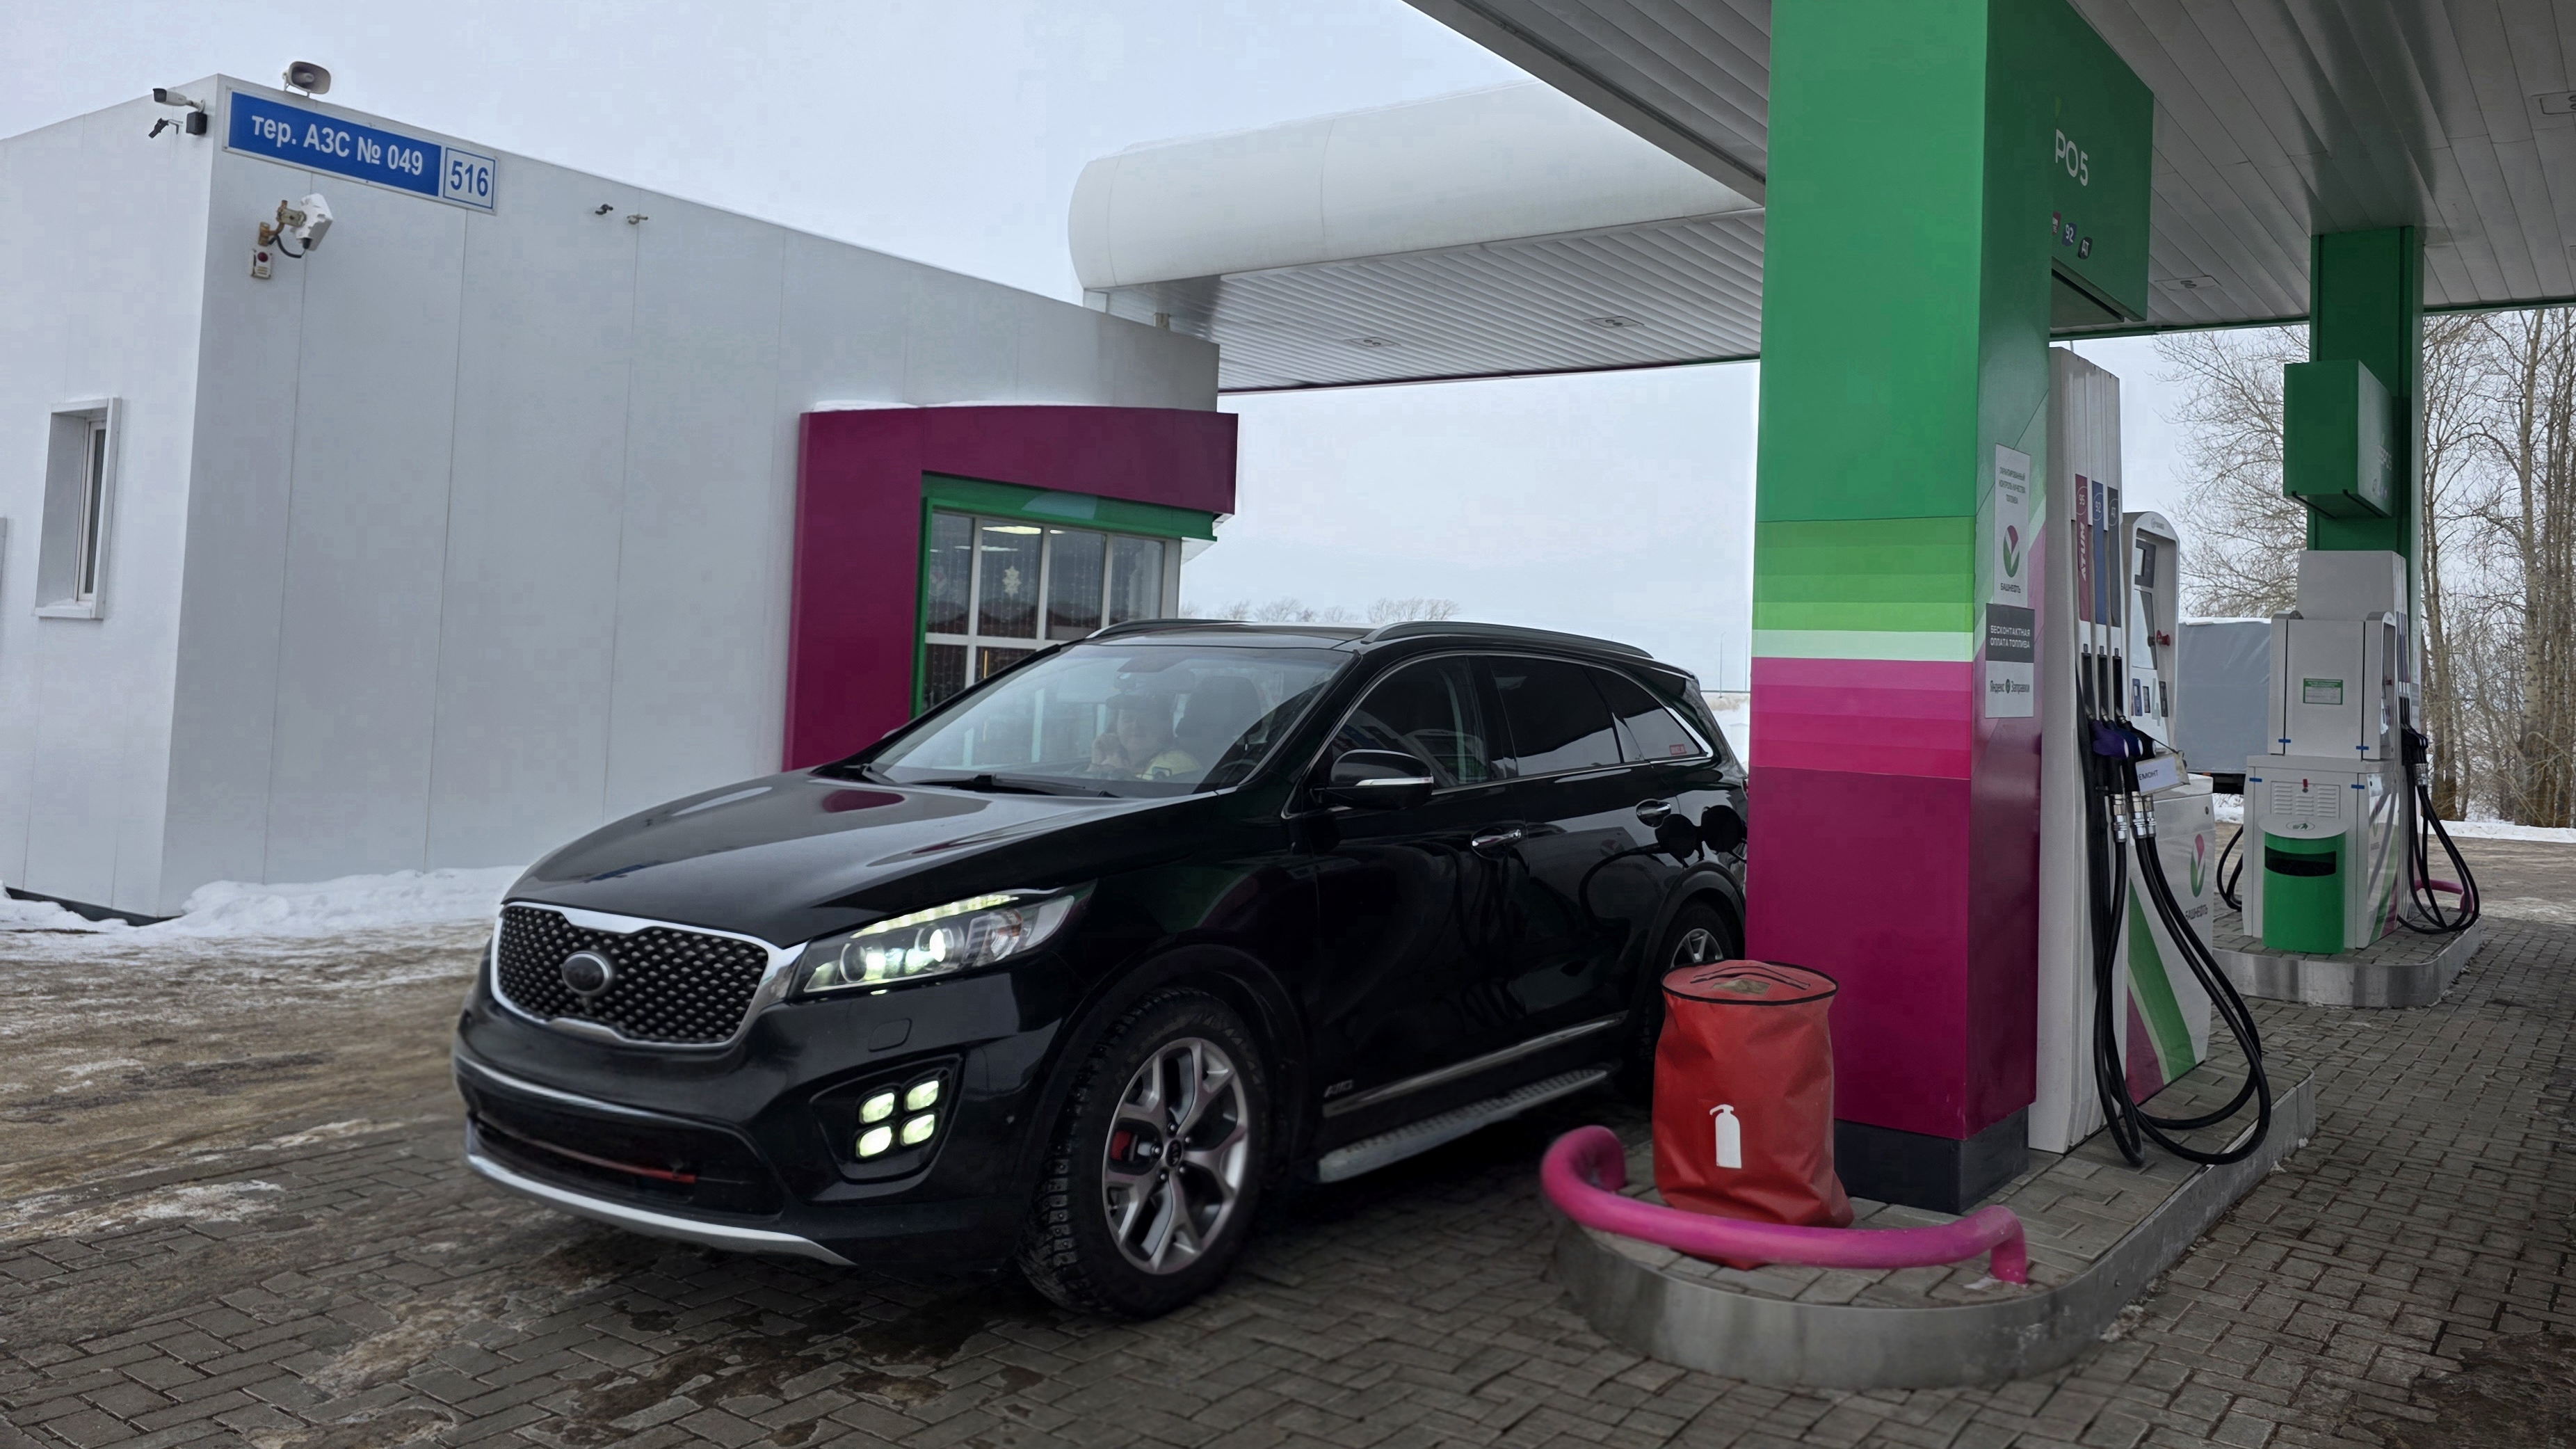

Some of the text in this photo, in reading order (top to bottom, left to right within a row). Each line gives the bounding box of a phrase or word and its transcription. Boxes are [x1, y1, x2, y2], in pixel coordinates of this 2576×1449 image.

[252, 115, 424, 176] тер. АЗС № 049
[2055, 129, 2088, 187] РО5
[450, 159, 489, 198] 516
[2066, 223, 2074, 243] 92
[2079, 493, 2086, 506] 95
[2095, 500, 2102, 513] 92
[1990, 625, 2031, 637] БЕСКОНТАКТНАЯ
[1990, 637, 2031, 649] ОПЛАТА ТОПЛИВА
[1990, 679, 2005, 694] Яндекс
[2138, 769, 2159, 780] ЕМОНТ
